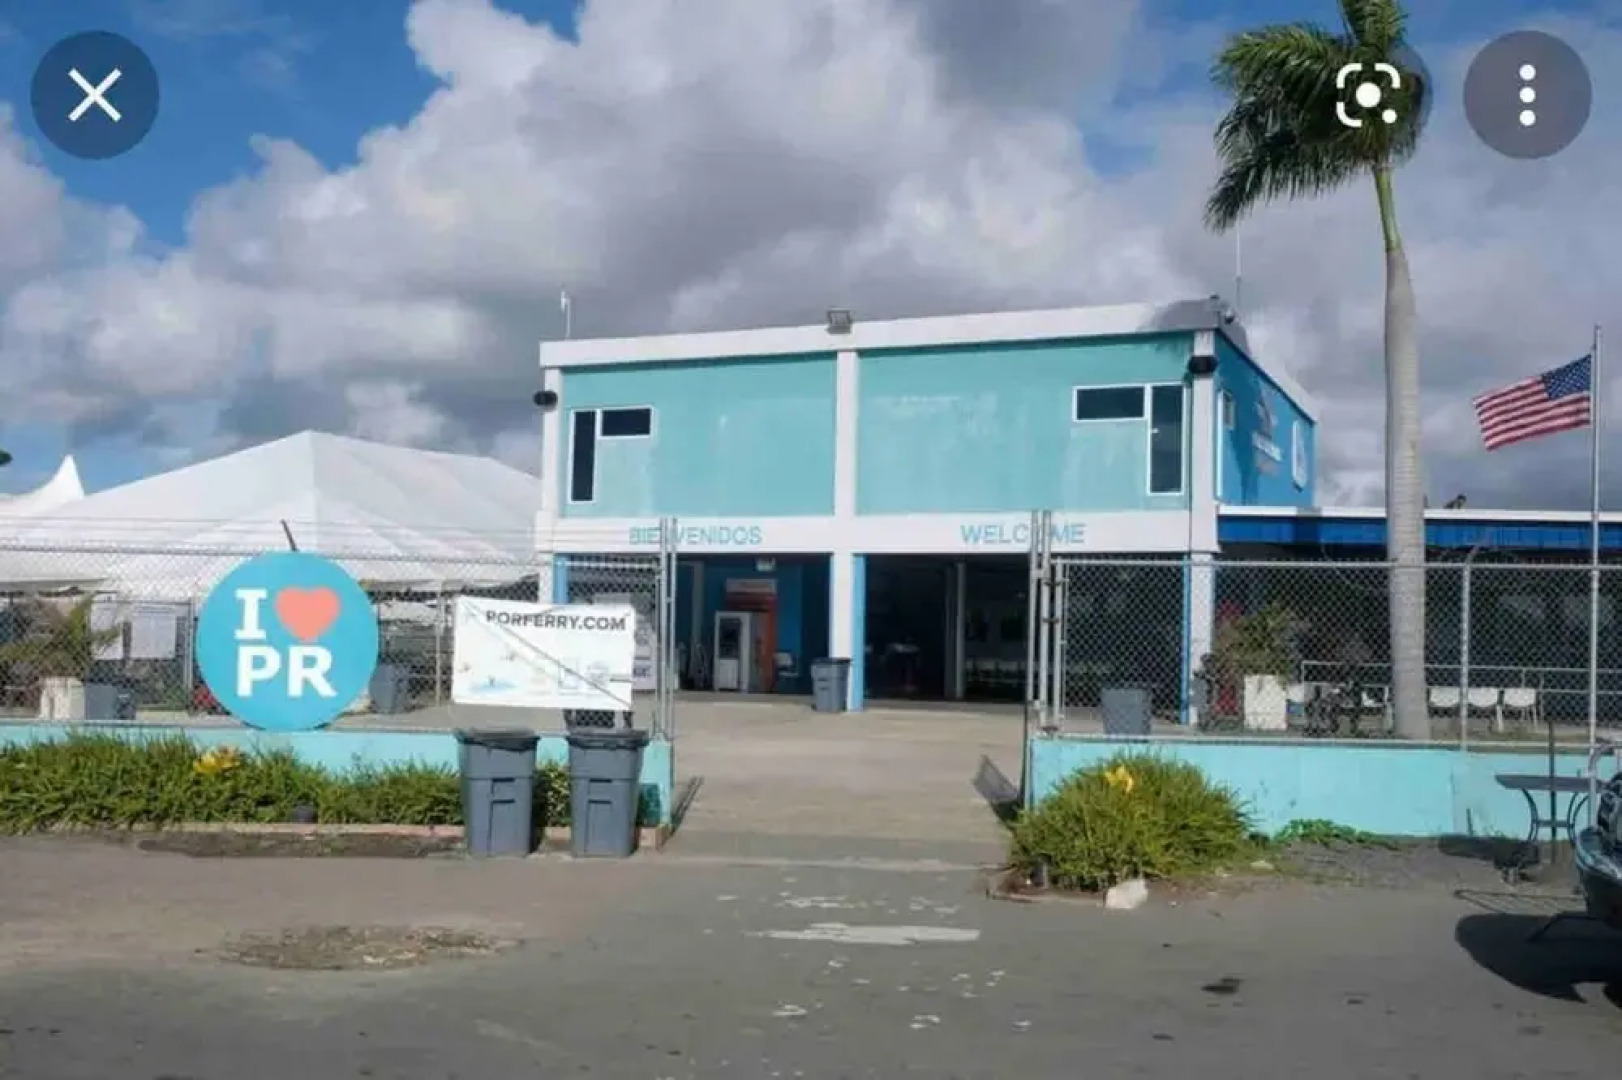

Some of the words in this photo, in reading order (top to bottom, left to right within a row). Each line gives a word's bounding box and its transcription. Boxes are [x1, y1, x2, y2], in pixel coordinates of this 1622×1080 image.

[629, 526, 762, 545] BIEVENIDOS
[960, 523, 1086, 544] WELCME
[234, 588, 267, 640] I
[486, 609, 626, 631] PORFERRY.COM
[237, 645, 338, 698] PR
